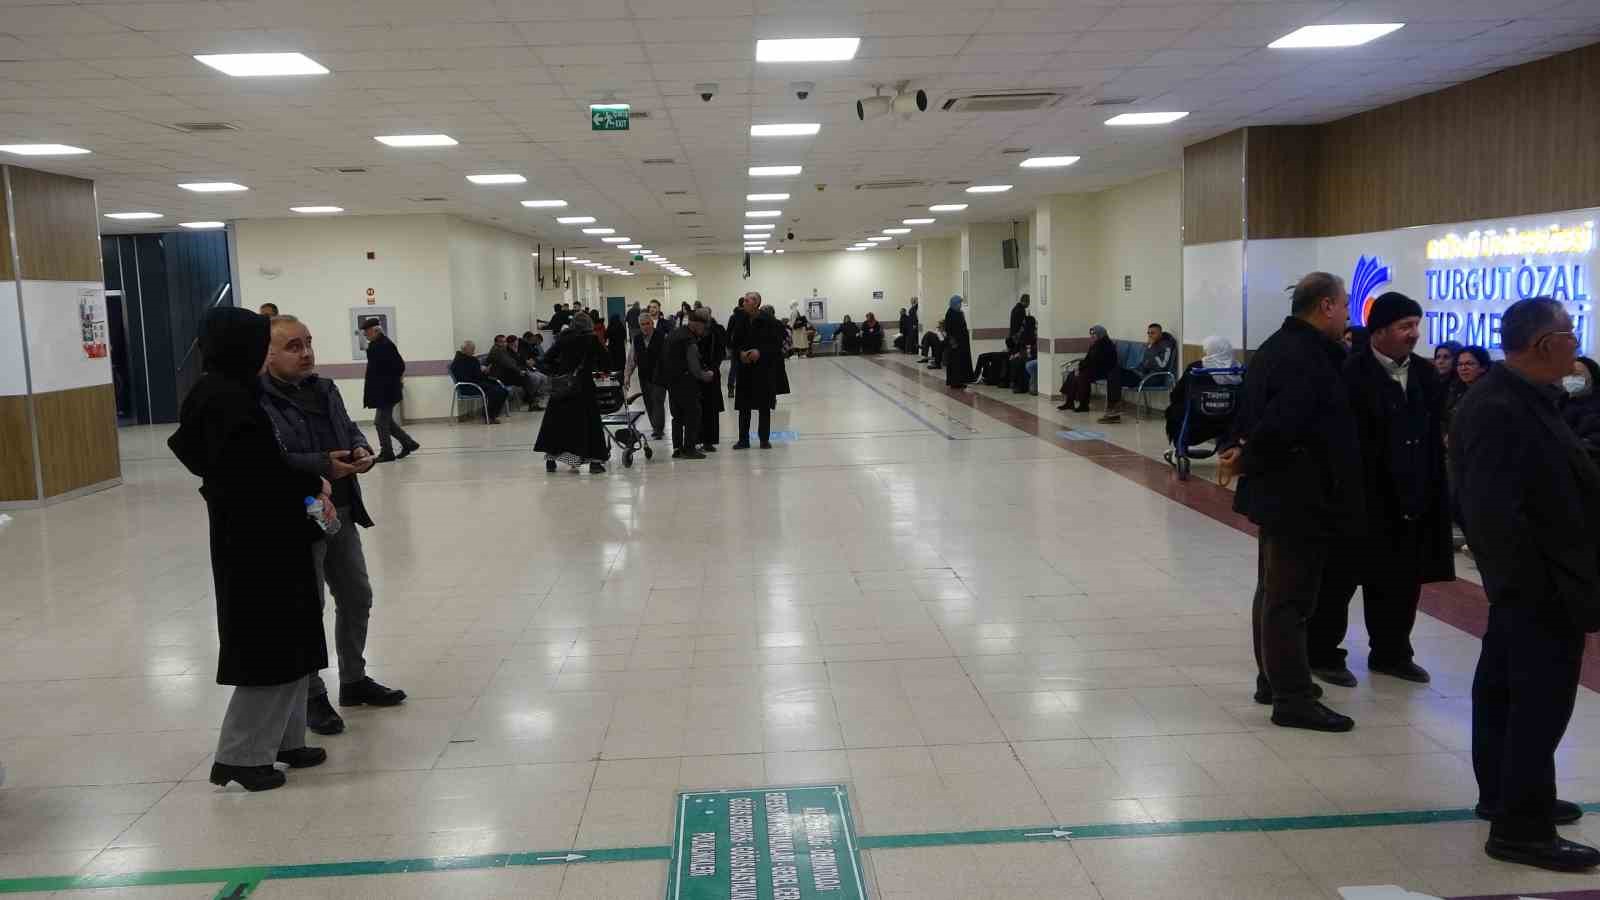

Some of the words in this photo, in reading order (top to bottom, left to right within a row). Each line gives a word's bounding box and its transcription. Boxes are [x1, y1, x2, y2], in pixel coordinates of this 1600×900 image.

[1425, 266, 1512, 300] TURGUT
[1516, 258, 1588, 300] ÖZAL
[1425, 311, 1462, 344] TIP
